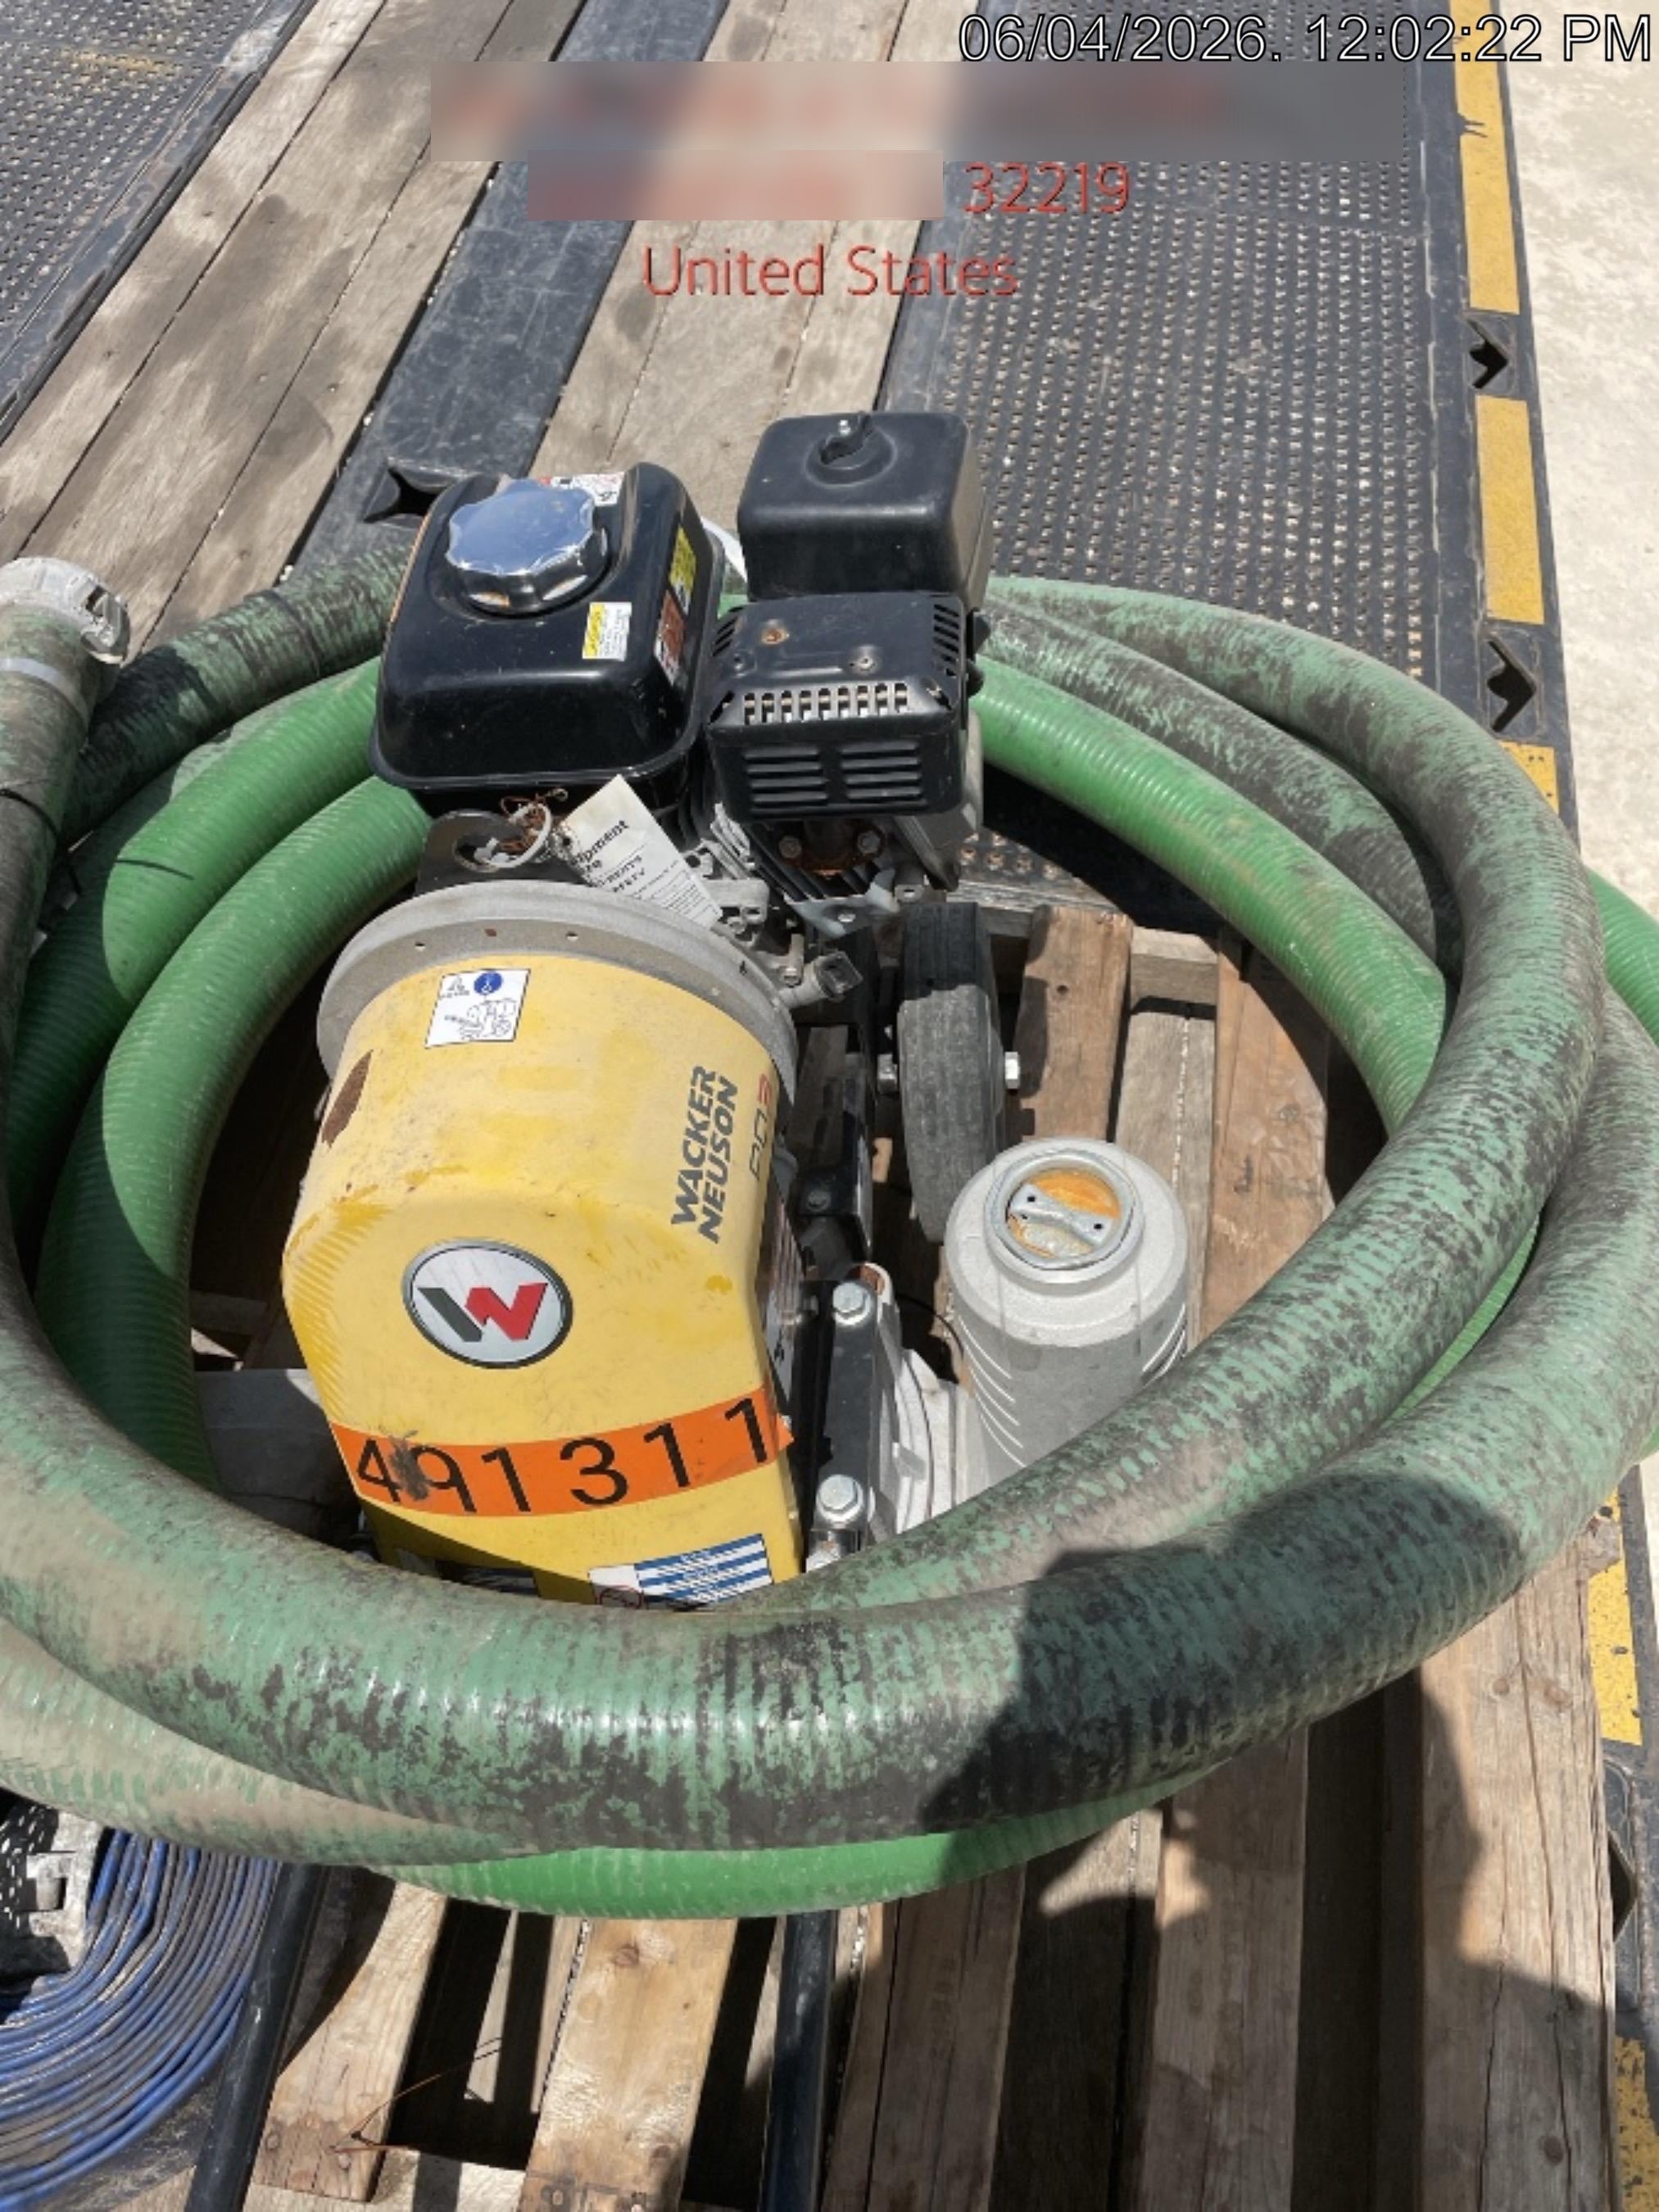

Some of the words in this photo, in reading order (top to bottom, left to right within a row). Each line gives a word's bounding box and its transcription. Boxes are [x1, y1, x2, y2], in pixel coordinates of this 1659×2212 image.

[671, 1066, 715, 1224] WACKER
[698, 1075, 738, 1244] NEUSON
[356, 1398, 768, 1513] 491311
